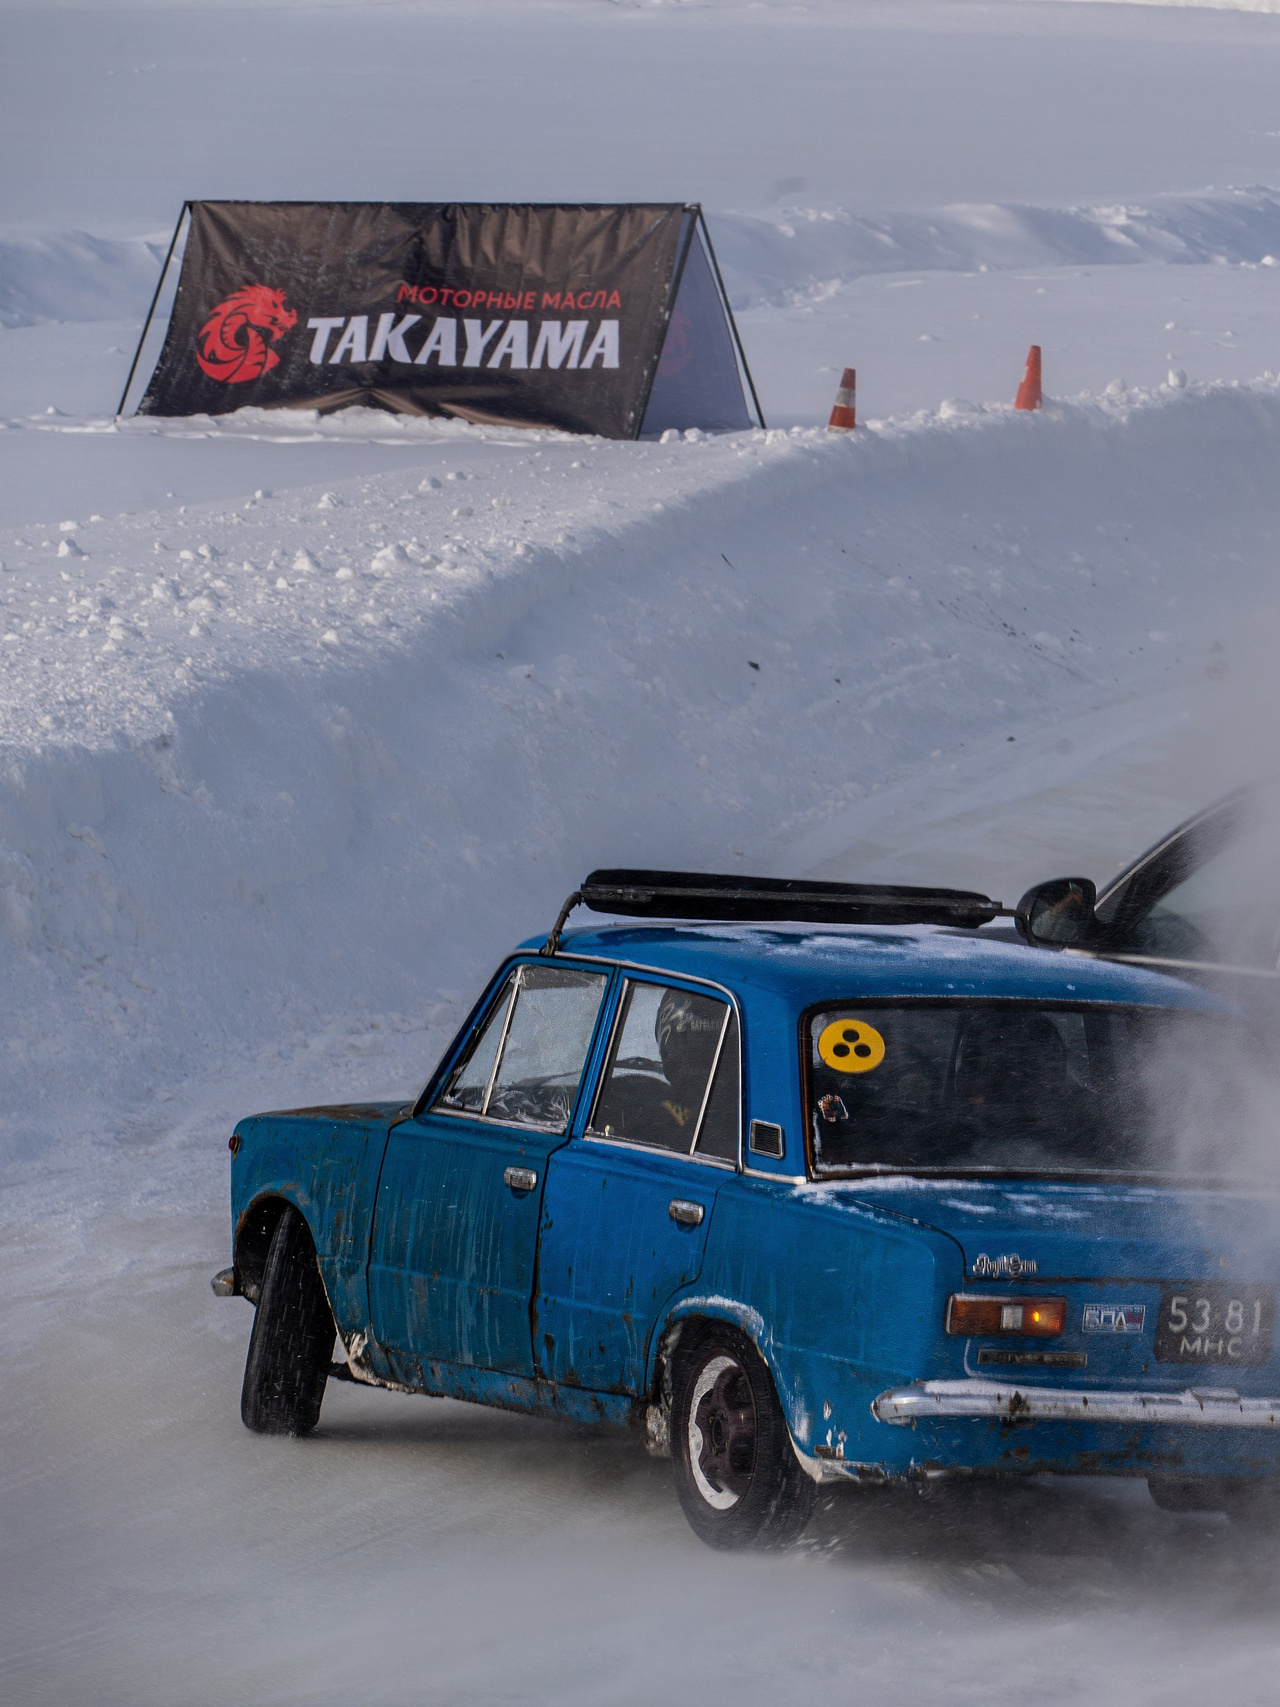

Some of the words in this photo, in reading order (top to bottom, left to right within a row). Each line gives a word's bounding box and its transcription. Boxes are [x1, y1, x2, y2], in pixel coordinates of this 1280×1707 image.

[397, 285, 537, 310] МОТОРНЫЕ
[541, 290, 621, 310] МАСЛА
[307, 312, 620, 370] TAKAYAMA
